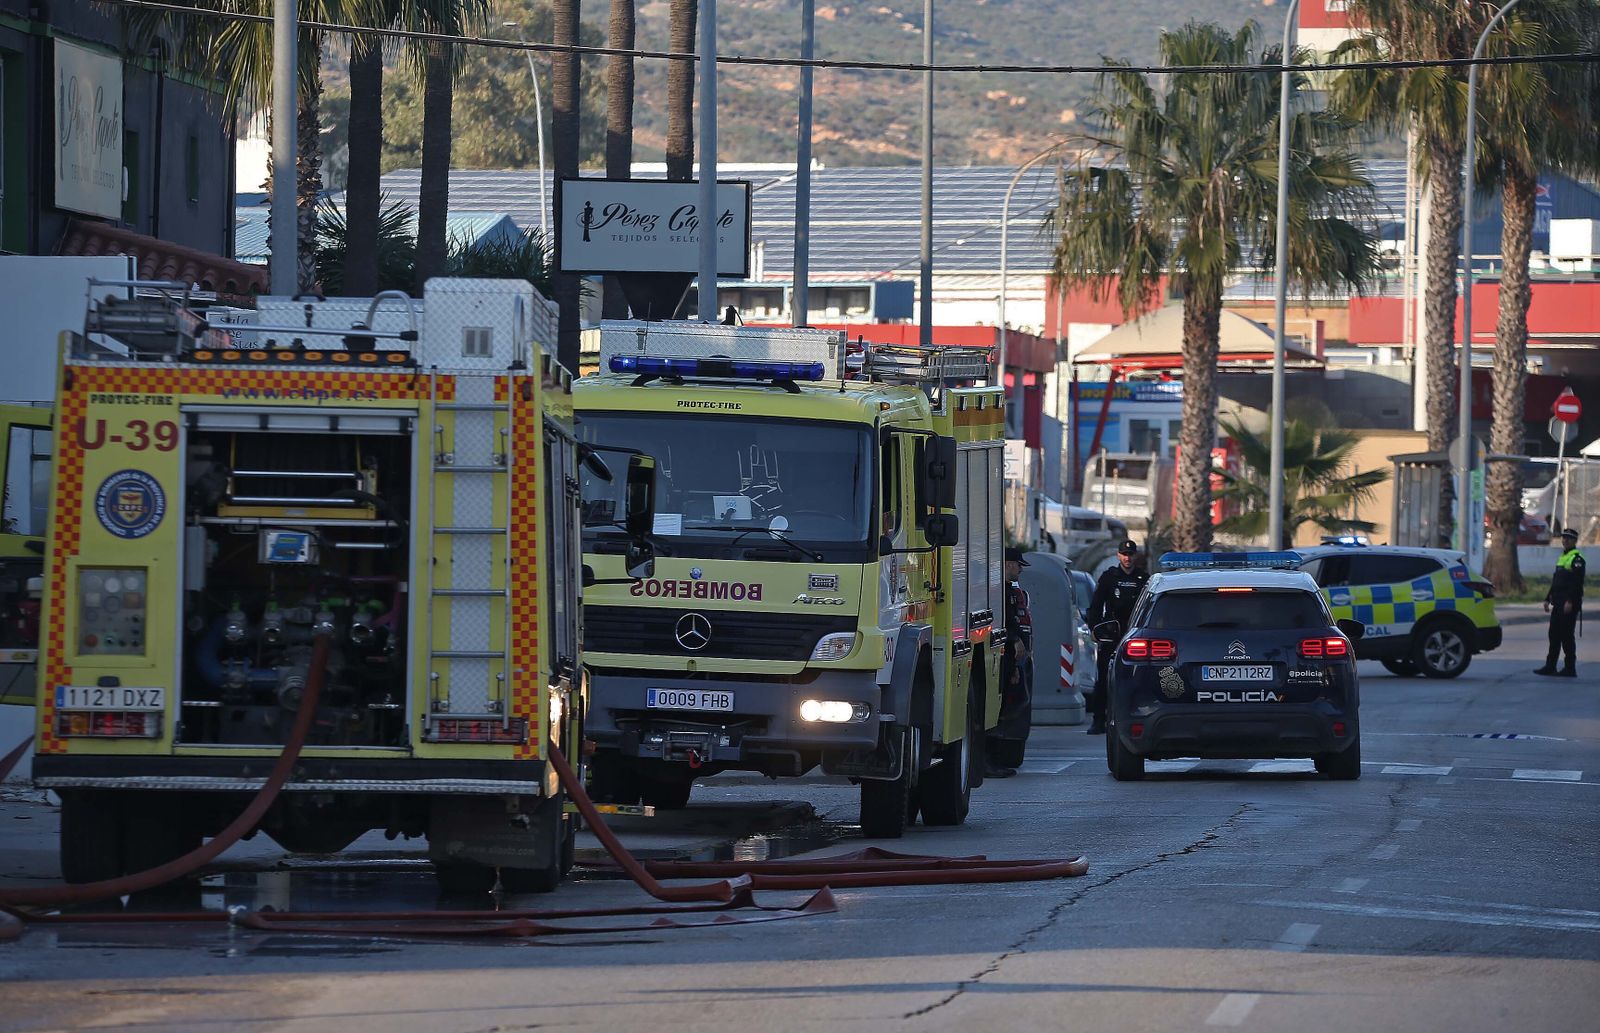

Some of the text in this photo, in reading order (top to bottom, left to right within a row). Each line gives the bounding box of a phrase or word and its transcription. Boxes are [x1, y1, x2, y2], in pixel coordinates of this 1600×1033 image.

[587, 202, 735, 234] Pérez Capte
[611, 234, 725, 244] TEJIDOS SELES
[90, 393, 174, 406] PROTEC-FIRE
[676, 400, 743, 410] PROTEC-FIRE
[76, 418, 179, 452] U-39
[70, 688, 161, 707] 1121 DXZ
[658, 691, 730, 708] 0009 FHB
[1196, 689, 1278, 702] POLICÍA
